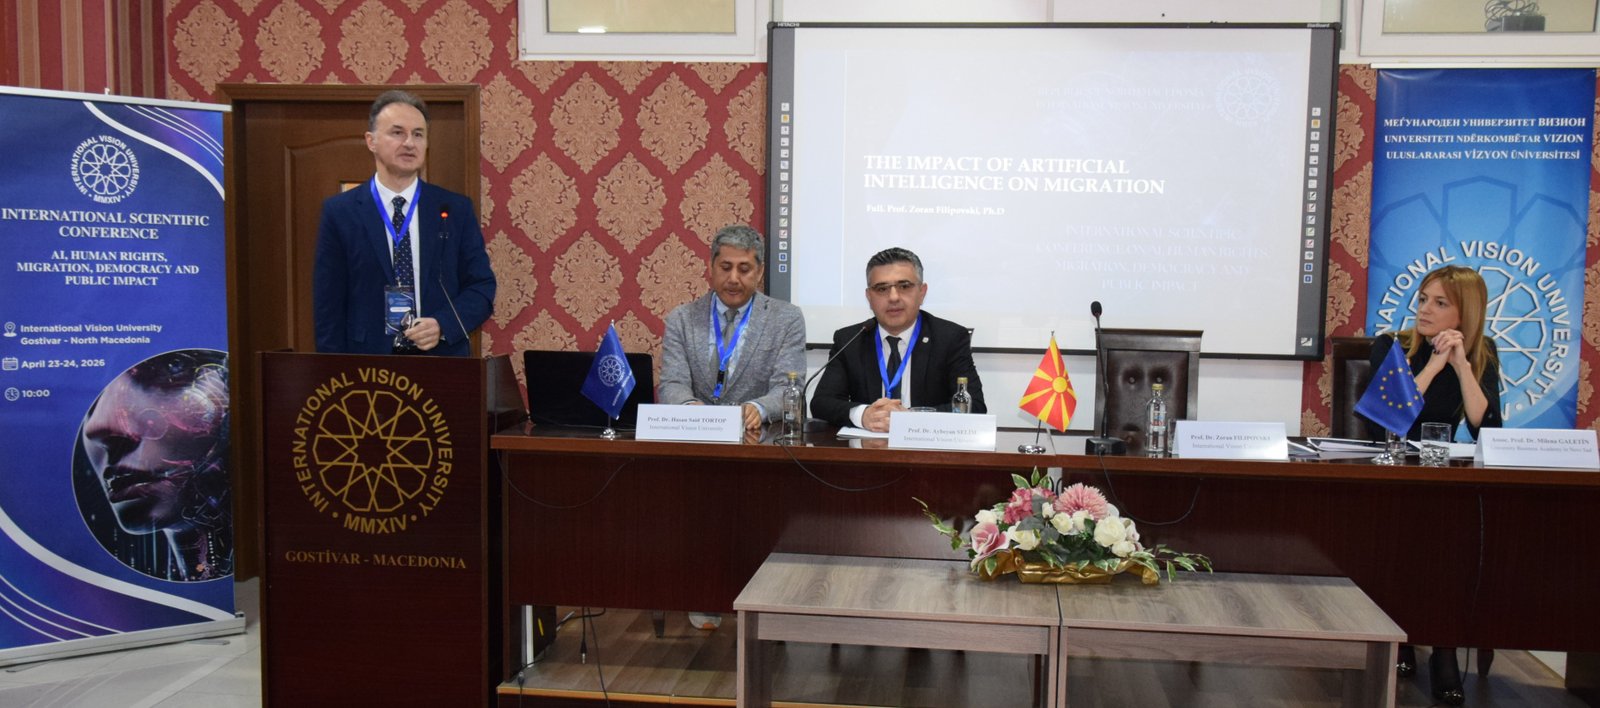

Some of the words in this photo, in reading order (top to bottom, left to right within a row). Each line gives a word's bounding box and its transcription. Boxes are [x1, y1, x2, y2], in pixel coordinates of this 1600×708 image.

[1383, 118, 1460, 128] МЕЃУНАРОДЕН
[1462, 118, 1536, 127] УНИВЕРЗИТЕТ
[1538, 117, 1586, 127] ВИЗИОН
[1384, 134, 1455, 143] UNIVERSITETI
[1456, 133, 1541, 143] NDËRKOMBËTAR
[1543, 133, 1584, 143] VIZION
[1386, 151, 1462, 160] ULUSLARARASI
[1464, 149, 1508, 160] VİZYON
[1511, 150, 1580, 160] ÜNİVERSİTESİ
[71, 136, 98, 195] INTERNATIONAL
[98, 135, 127, 150] VISION
[125, 148, 140, 197] UNIVERSITY
[863, 154, 902, 170] THE
[906, 155, 983, 171] IMPACT
[986, 156, 1013, 172] OF
[1017, 157, 1131, 175] ARTIFICIAL
[863, 173, 1004, 191] INTELLIGENCE
[1008, 176, 1038, 192] ON
[1043, 177, 1167, 194] MIGRATION
[909, 205, 934, 214] Zoran
[1, 208, 126, 223] INTERNATIONAL
[129, 213, 210, 226] SCIENTIFIC
[59, 226, 159, 240] CONFERENCE
[51, 251, 68, 261] AI,
[71, 251, 117, 261] HUMAN
[120, 252, 167, 262] RIGHTS,
[17, 262, 94, 274] MIGRATION,
[95, 263, 172, 274] DEMOCRACY
[175, 265, 200, 274] AND
[65, 276, 110, 285] PUBLIC
[113, 277, 158, 286] IMPACT
[116, 324, 162, 333] University
[1461, 240, 1541, 277] VISION
[1525, 273, 1571, 406] UNIVERSITY
[20, 337, 61, 345] Gostivar
[70, 336, 98, 344] North
[100, 336, 150, 344] Macedonia
[21, 360, 45, 369] April
[48, 360, 78, 369] 23-24,
[81, 359, 105, 367] 2026
[293, 372, 354, 512] INTERNATIONAL
[358, 368, 424, 401] VISION
[419, 398, 453, 517] UNIVERSITY
[343, 513, 407, 534] MMXIV
[285, 549, 360, 564] GOSTİVAR
[373, 554, 466, 569] MACEDONIA
